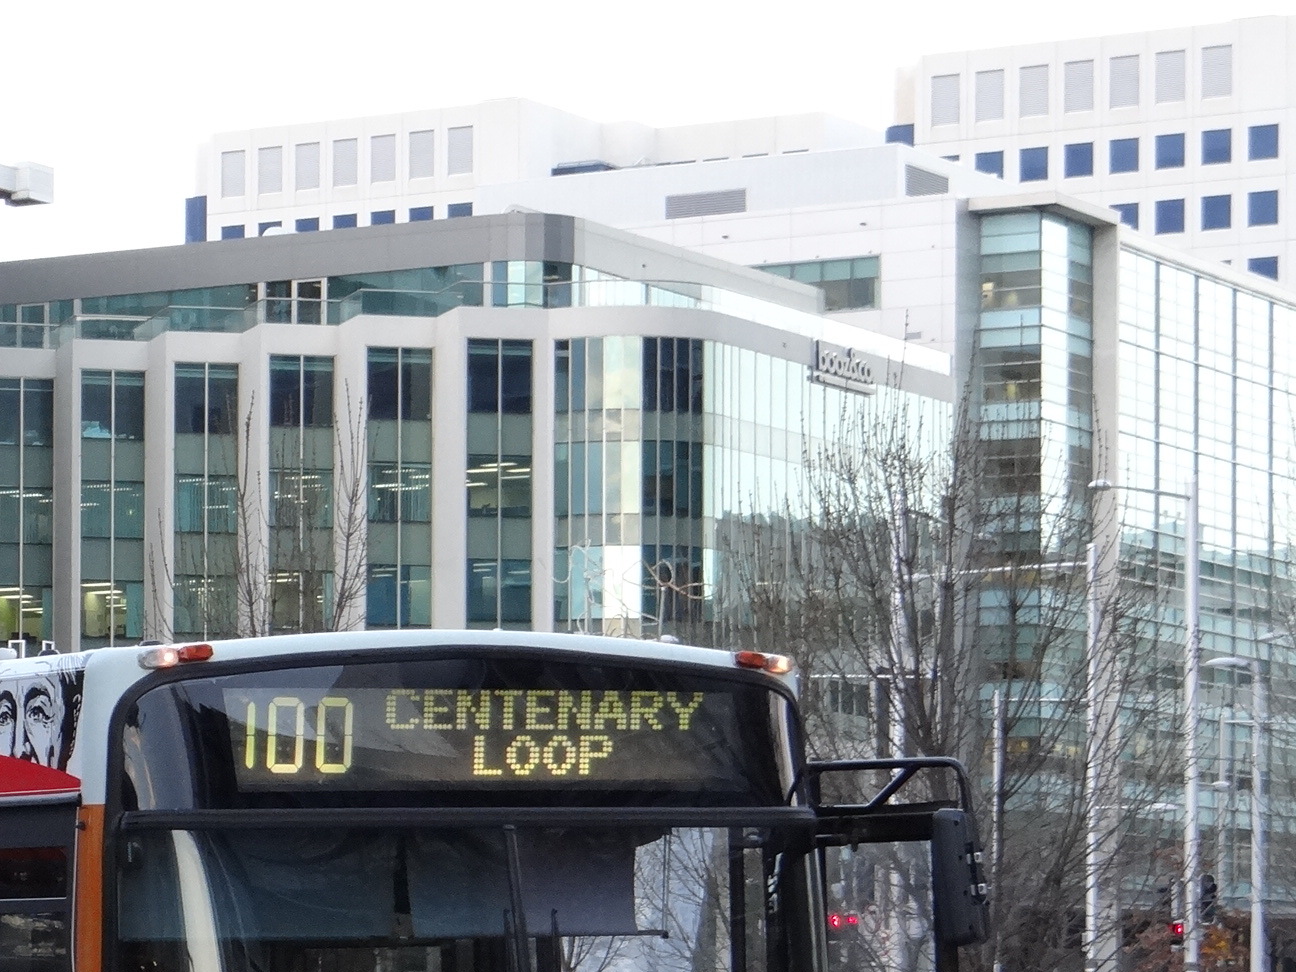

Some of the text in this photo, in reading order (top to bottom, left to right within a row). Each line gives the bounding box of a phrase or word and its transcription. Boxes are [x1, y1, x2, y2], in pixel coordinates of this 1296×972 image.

[384, 688, 705, 731] CENTENARY
[244, 695, 354, 775] 100
[472, 735, 614, 776] LOOP
